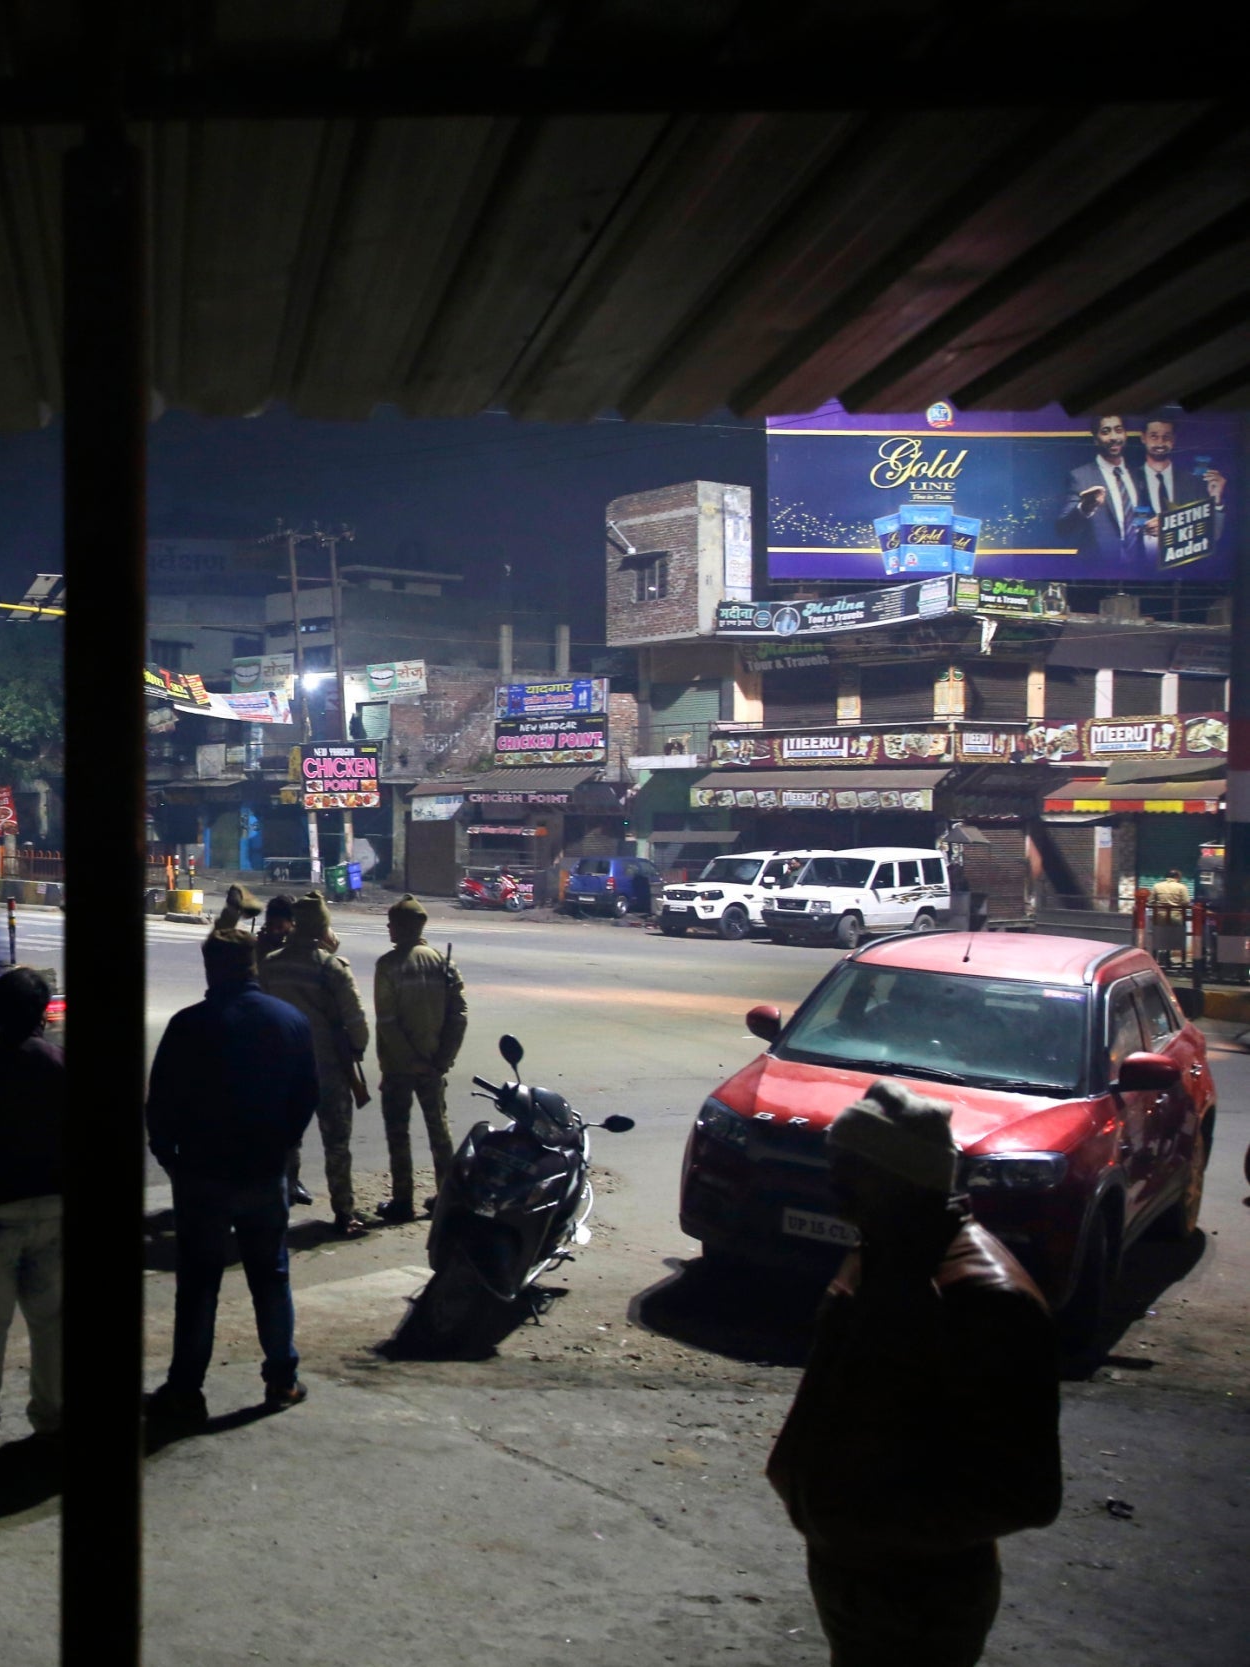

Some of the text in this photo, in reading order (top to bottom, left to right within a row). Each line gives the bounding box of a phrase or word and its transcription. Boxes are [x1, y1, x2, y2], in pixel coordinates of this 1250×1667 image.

[870, 437, 969, 489] Gold
[909, 482, 956, 491] LINE
[1162, 504, 1210, 531] JEETNE
[907, 525, 945, 545] Gold
[1178, 524, 1194, 542] Ki
[1164, 538, 1208, 562] Aadat
[719, 606, 754, 619] मदीना
[802, 597, 865, 616] Madina
[807, 615, 826, 624] Tour
[834, 610, 864, 622] Travels
[746, 659, 774, 671] Tour
[785, 655, 830, 669] Travels
[525, 683, 574, 694] यादगार
[519, 724, 538, 732] NEW
[1091, 723, 1156, 750] MEERUT
[496, 732, 603, 750] CHICKEN POINT
[303, 757, 377, 778] CHICKEN
[324, 779, 359, 791] POINT
[469, 794, 523, 803] CHICKEN
[528, 794, 569, 803] POINT
[788, 1216, 807, 1231] UP
[810, 1220, 826, 1235] 15
